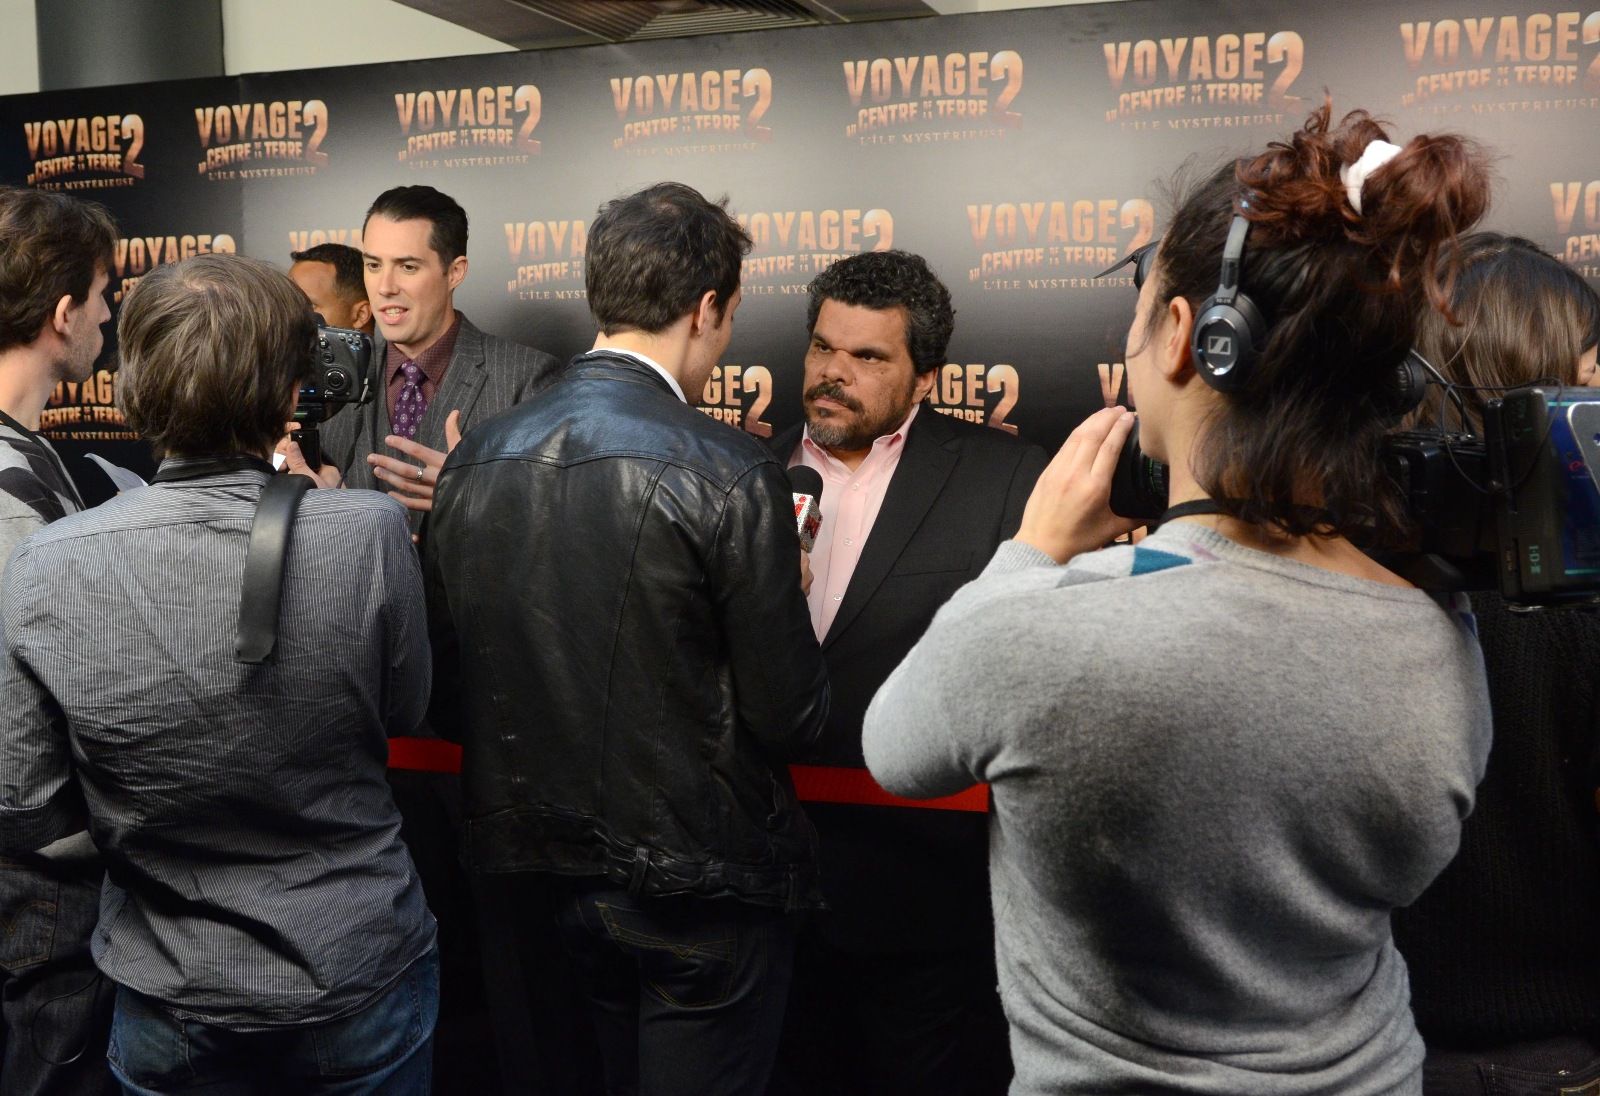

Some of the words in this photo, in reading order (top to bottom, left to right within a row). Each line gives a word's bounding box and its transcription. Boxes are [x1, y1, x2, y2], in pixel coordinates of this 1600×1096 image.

[1400, 12, 1580, 71] VOYAGE
[1103, 32, 1265, 91] VOYAGE
[610, 70, 741, 120] VOYAGE
[843, 52, 988, 106] VOYAGE
[1416, 68, 1491, 99] CENTRE
[394, 86, 513, 136] VOYAGE
[1119, 85, 1186, 115] CENTRE
[1206, 83, 1264, 106] TERRE
[194, 101, 303, 148] VOYAGE
[624, 117, 678, 143] CENTRE
[858, 102, 918, 133] CENTRE
[24, 115, 121, 160] VOYAGE
[408, 130, 456, 154] CENTRE
[35, 156, 75, 180] CENTRE
[207, 143, 251, 170] CENTRE
[737, 209, 861, 251] OYAGE
[967, 200, 1118, 249] VOYAGE
[504, 220, 587, 263] VOYA
[517, 262, 569, 286] CENTRE
[741, 255, 795, 281] CENTRE
[981, 247, 1044, 275] CENTRE
[1064, 246, 1117, 267] TERRE
[41, 407, 81, 429] CENTRE
